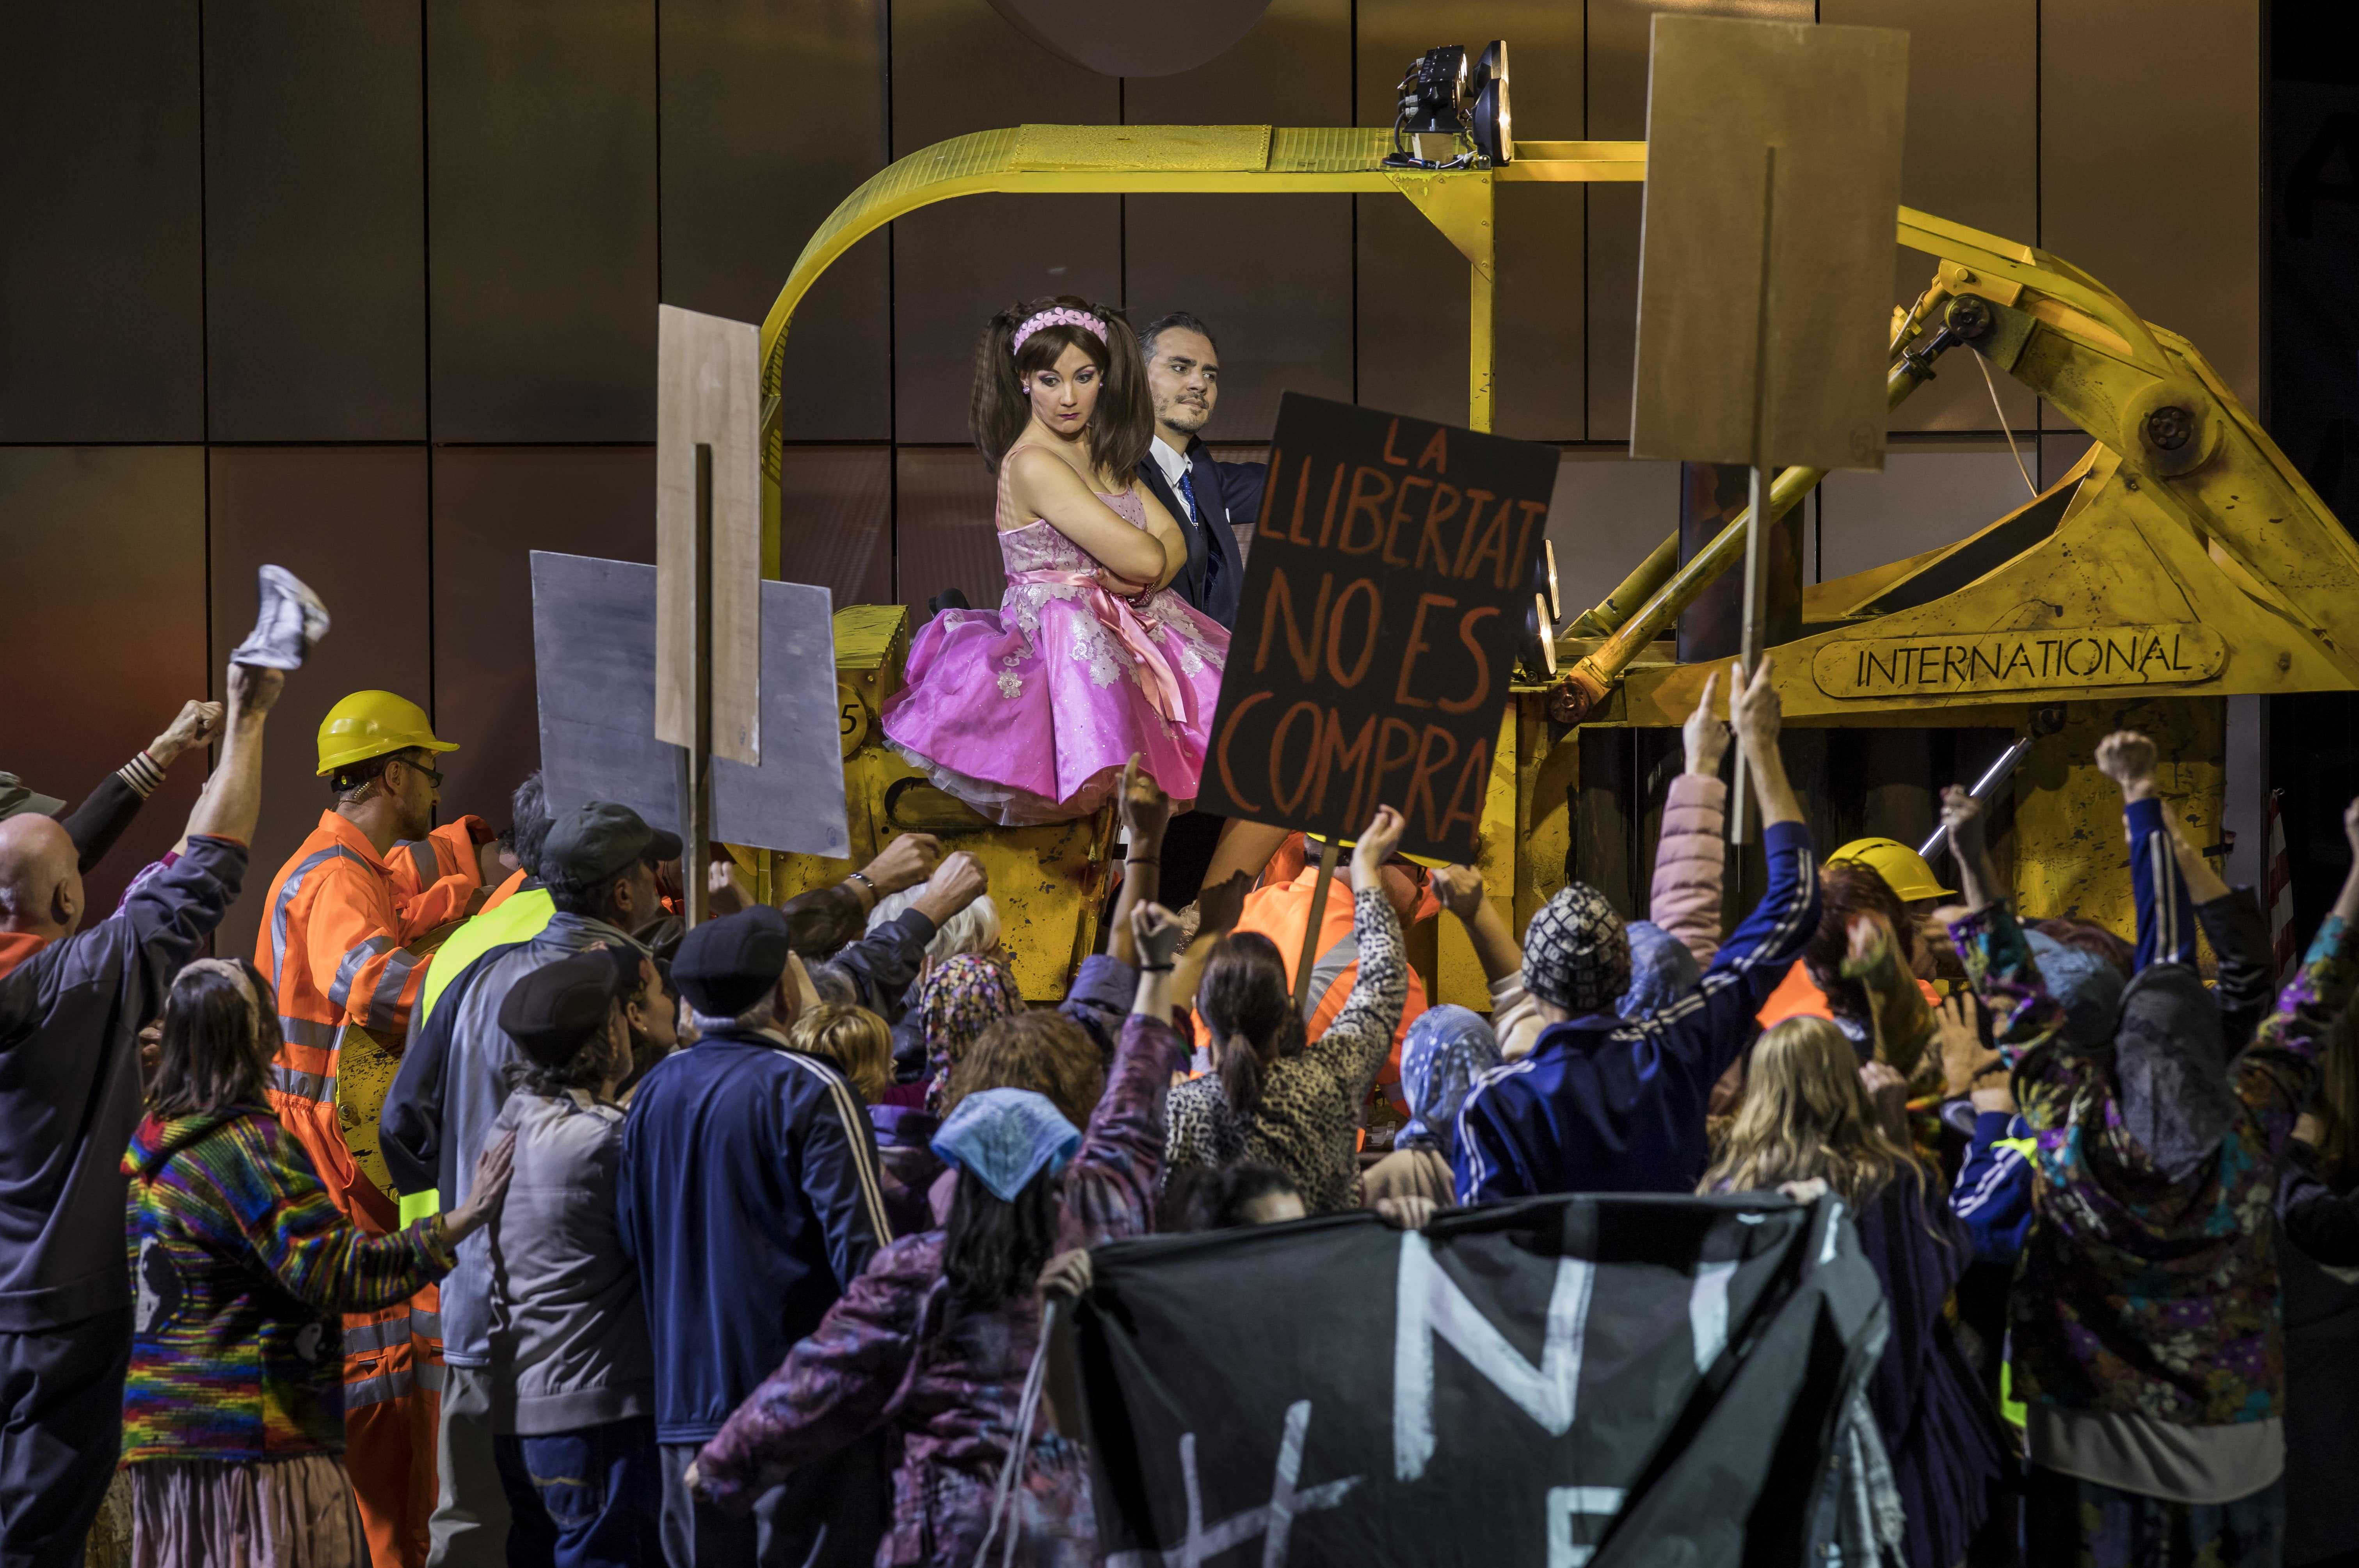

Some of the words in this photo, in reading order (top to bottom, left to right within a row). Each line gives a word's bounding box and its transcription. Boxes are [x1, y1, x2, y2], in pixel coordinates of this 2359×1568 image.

[1383, 419, 1446, 474] LA
[1258, 448, 1548, 590] LLIBERTAT
[1254, 567, 1381, 689] NO
[1395, 593, 1501, 714] ES
[1857, 634, 2192, 687] INTERNATIONAL
[1216, 691, 1488, 853] COMPRA
